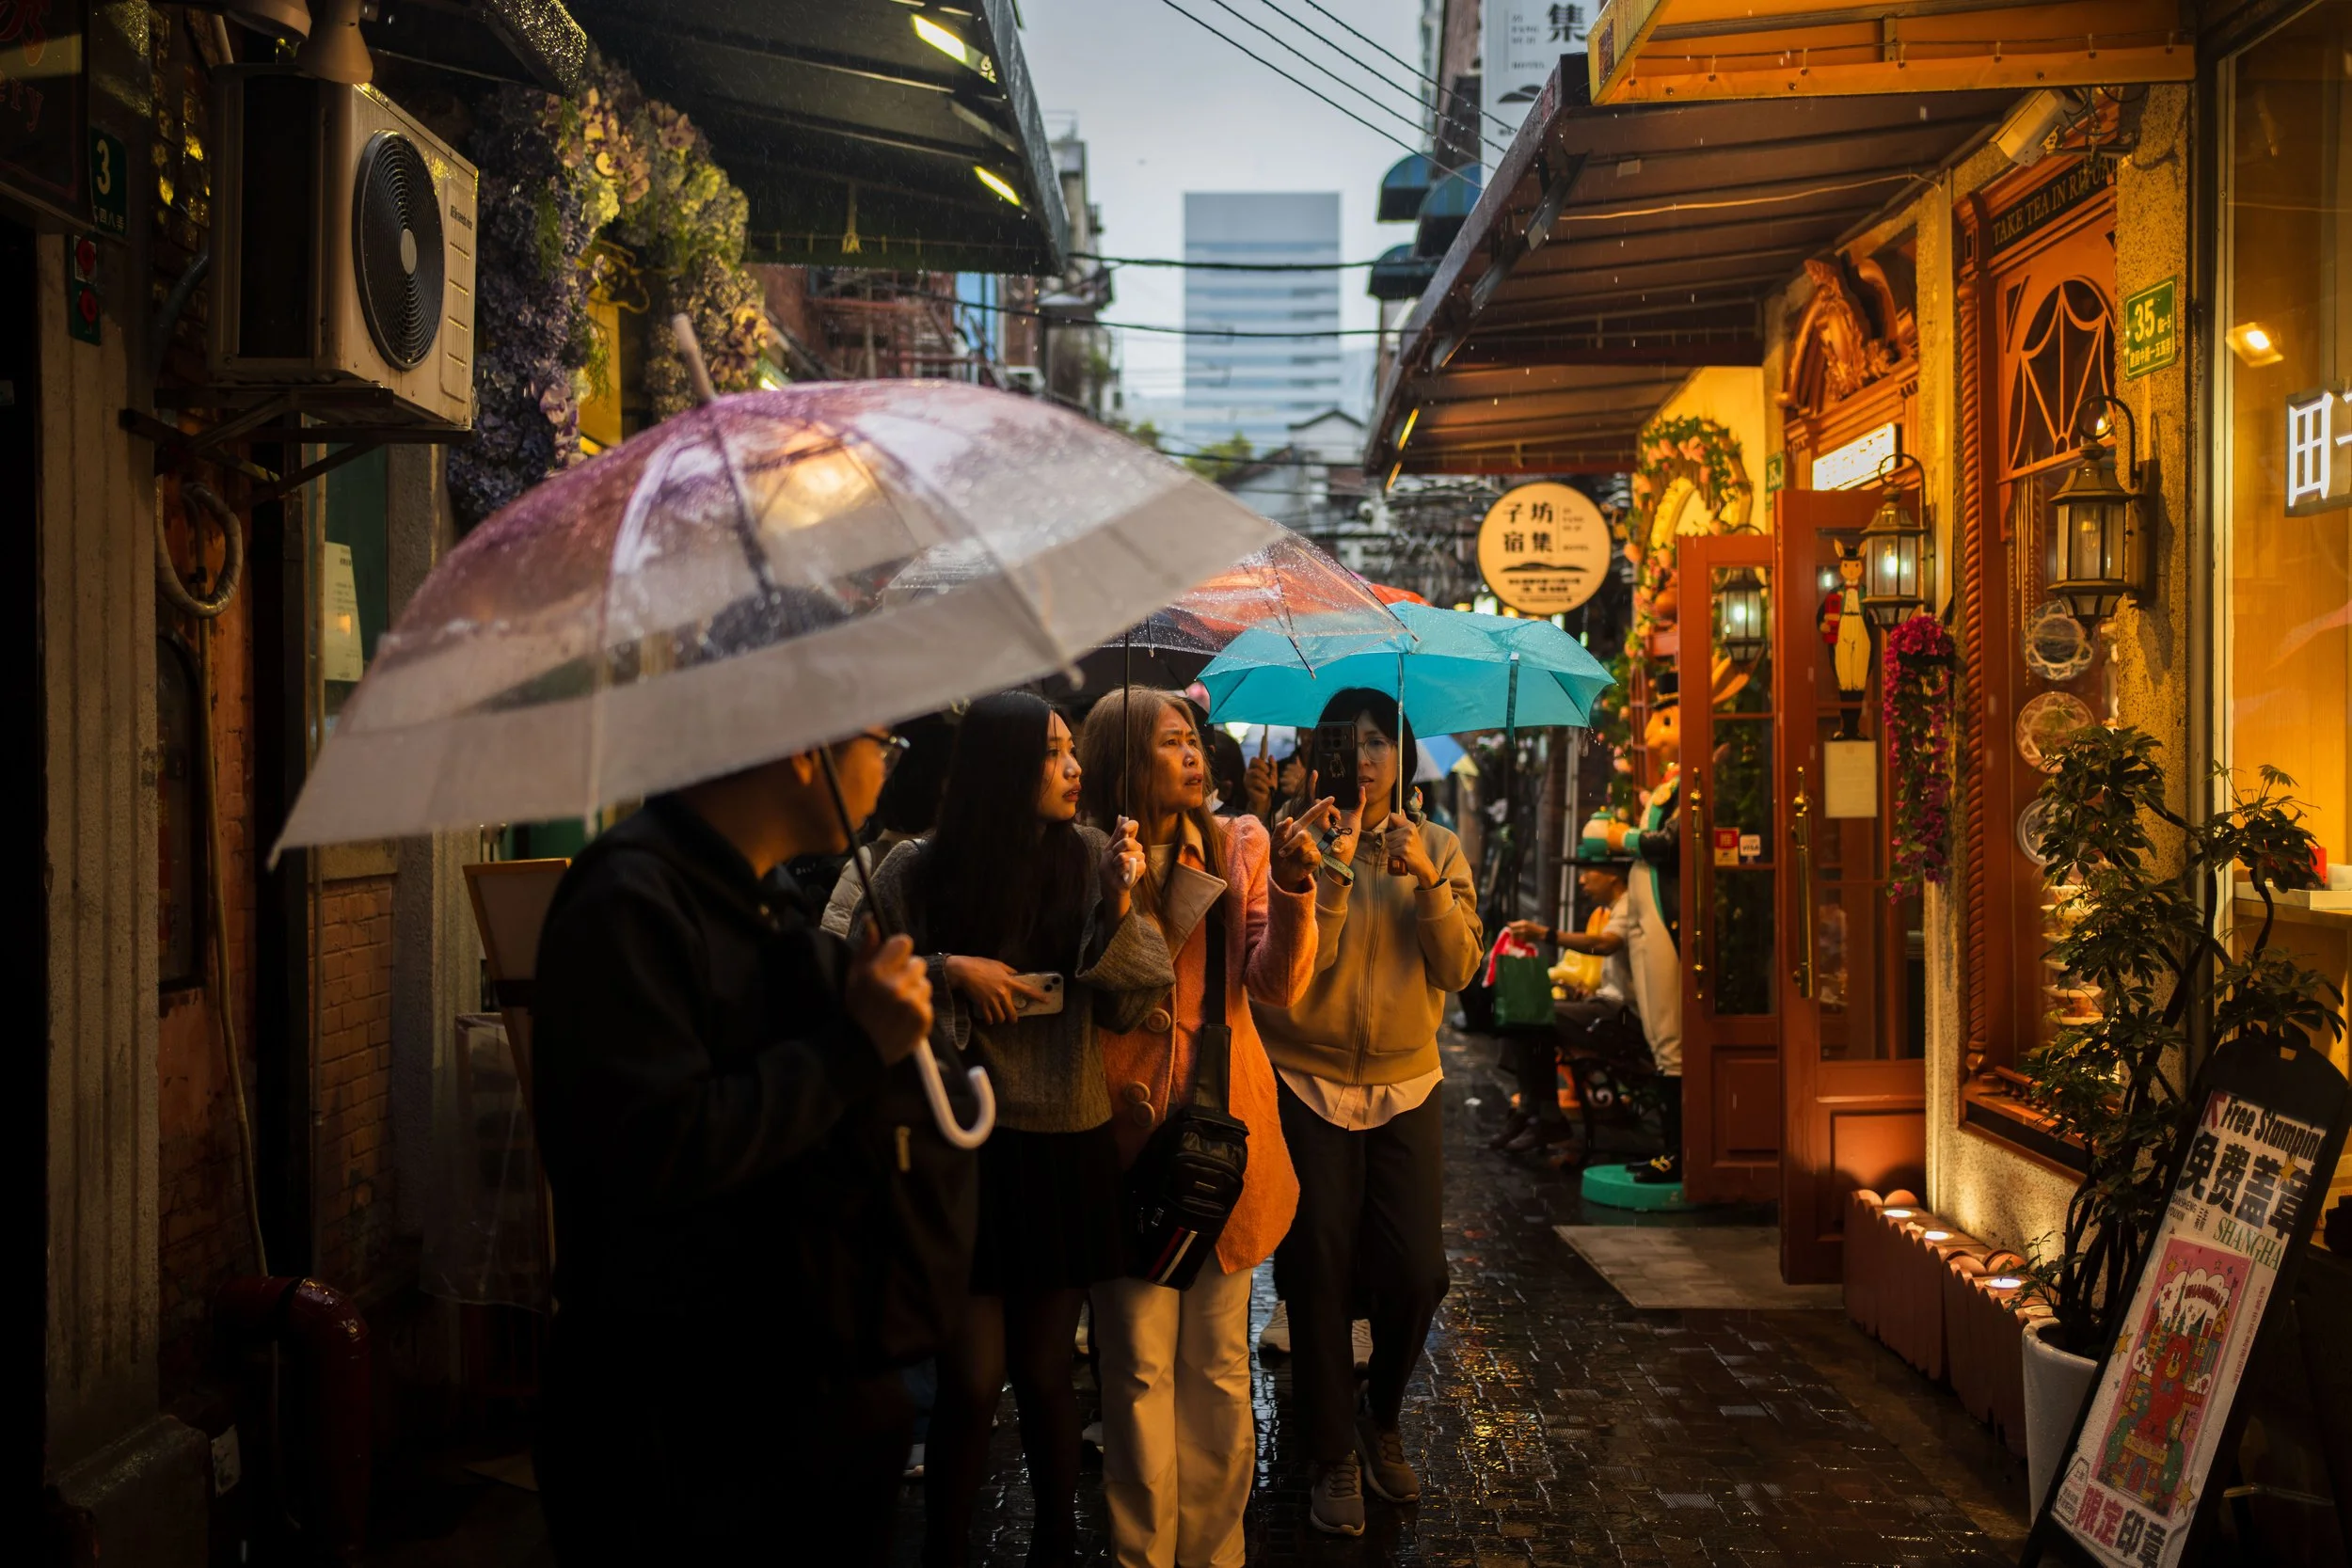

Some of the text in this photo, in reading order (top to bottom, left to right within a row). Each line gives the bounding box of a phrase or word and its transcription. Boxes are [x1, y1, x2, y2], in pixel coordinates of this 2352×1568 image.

[1548, 3, 1586, 42] 集
[97, 139, 111, 196] 3
[1994, 206, 2026, 246] TAKE
[2025, 191, 2051, 227] TEA
[2052, 178, 2067, 211] IN
[2134, 298, 2155, 342] 35
[2287, 388, 2352, 508] 田
[1504, 502, 1553, 523] 子坊
[2220, 1096, 2256, 1136] Free
[2175, 1131, 2314, 1240] 免费盖章
[2184, 1284, 2223, 1310] SHANGHAI
[2074, 1483, 2167, 1568] 限定印章
